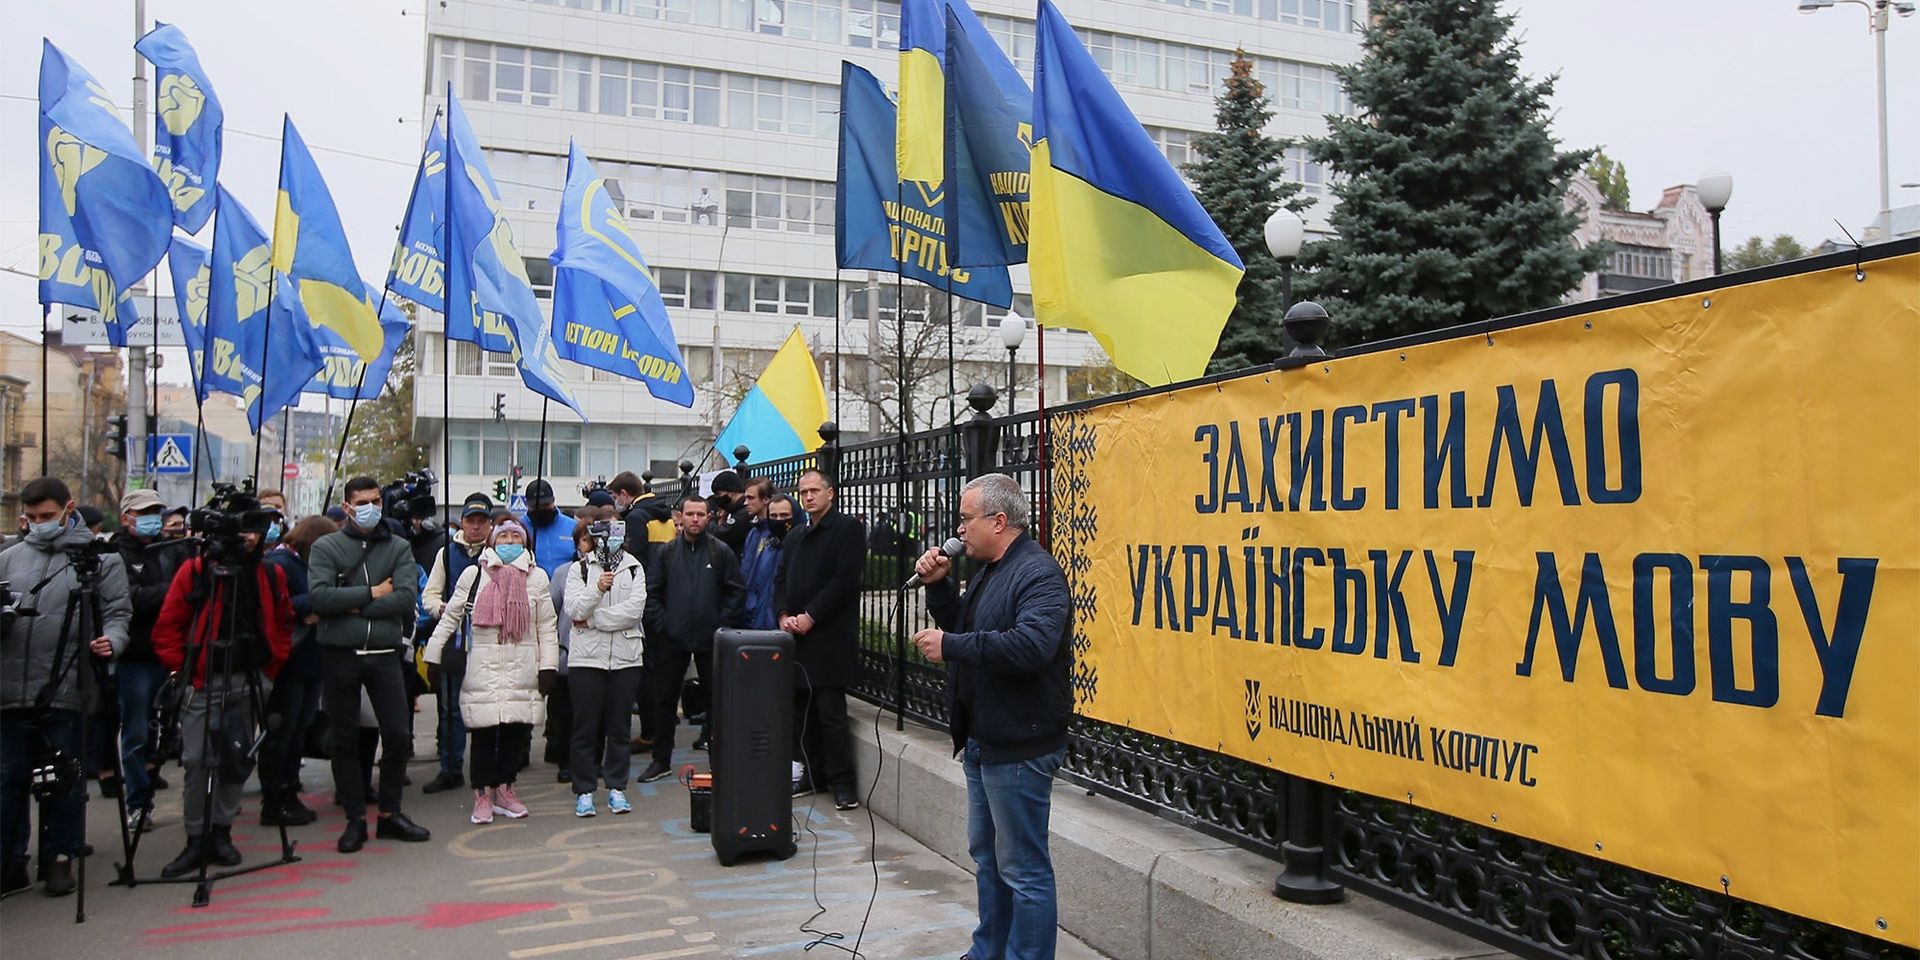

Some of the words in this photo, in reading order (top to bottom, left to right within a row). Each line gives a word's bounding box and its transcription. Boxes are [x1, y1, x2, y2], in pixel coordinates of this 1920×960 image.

[990, 172, 1030, 196] НАЦІО
[1194, 368, 1642, 514] ЗАХИСТИМО
[1126, 526, 1475, 667] УКРАЇНСЬКУ
[1515, 552, 1880, 717] МОВУ
[1268, 695, 1424, 762] НАЦІОНАЛЬНИЙ
[1430, 727, 1538, 787] КОРПУС
